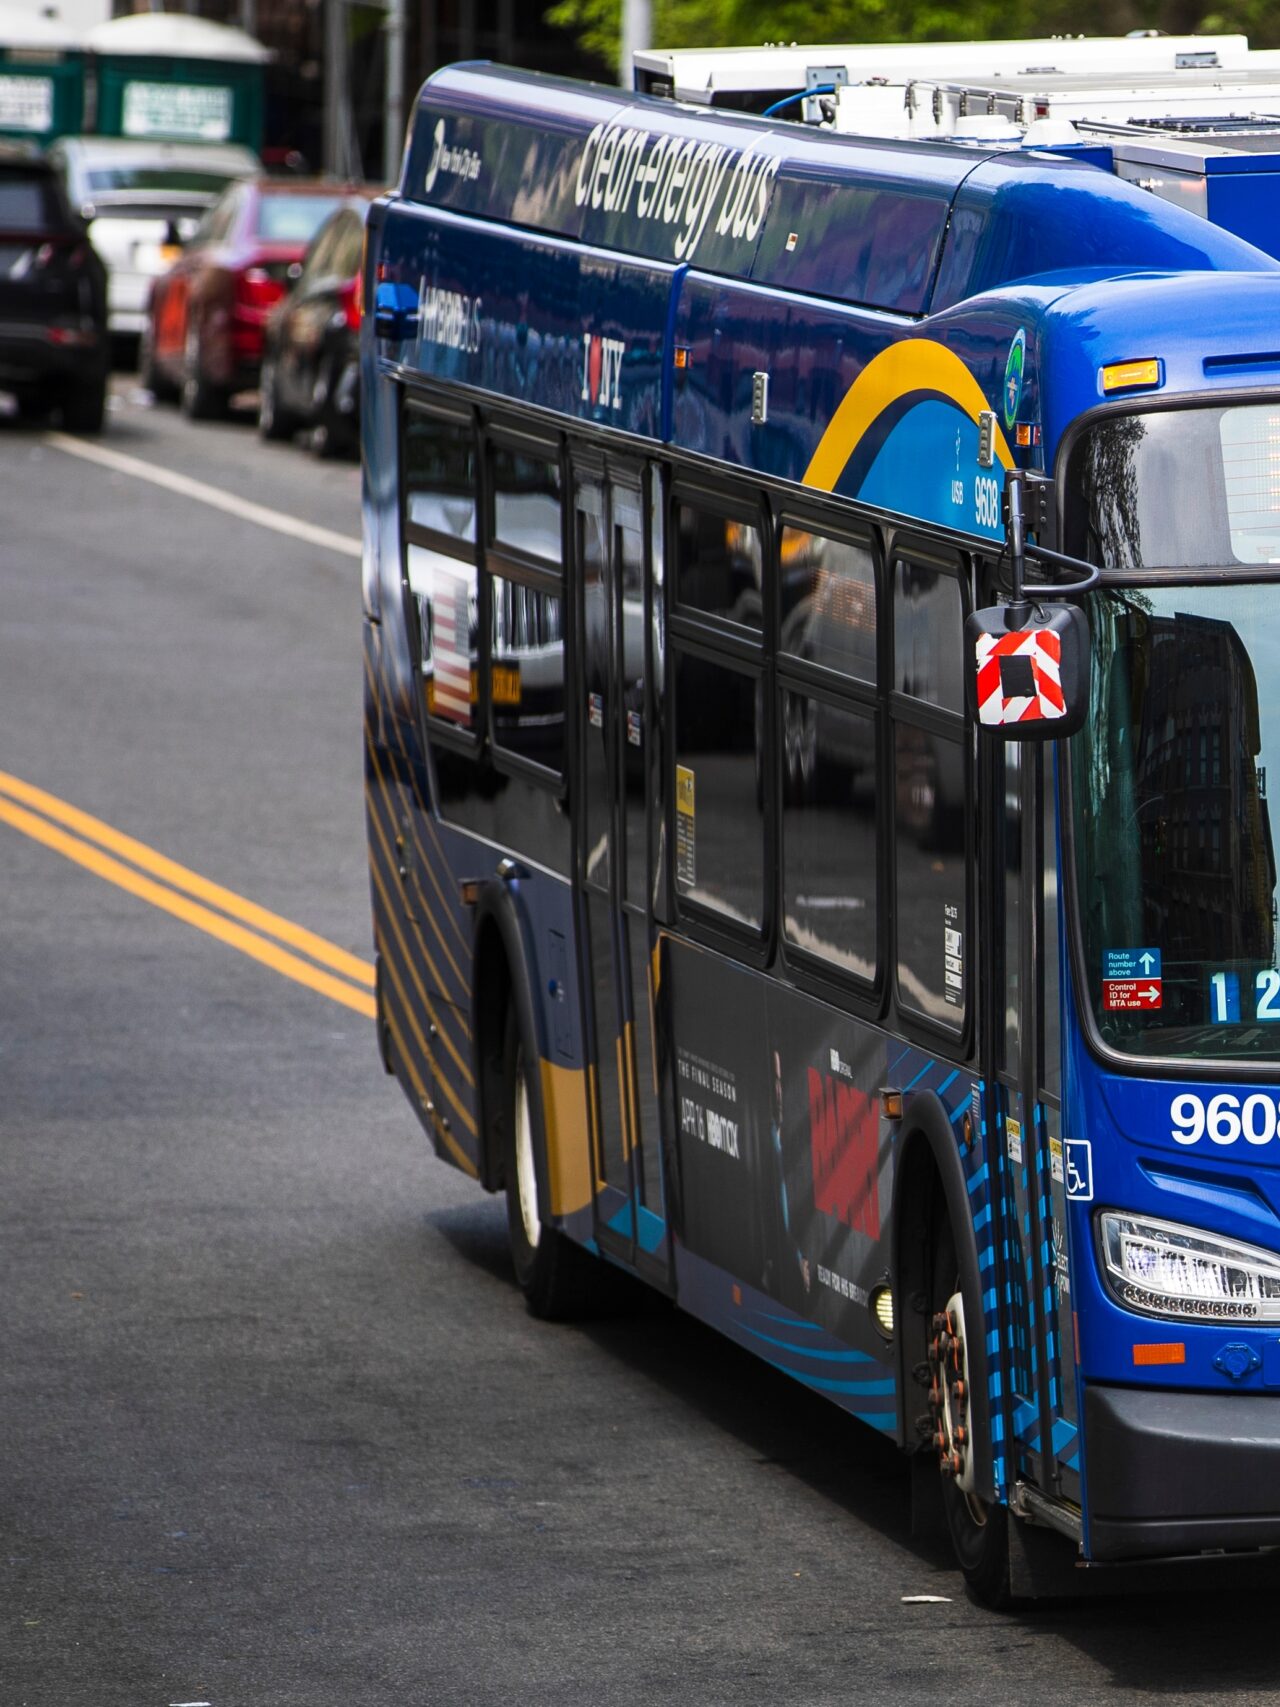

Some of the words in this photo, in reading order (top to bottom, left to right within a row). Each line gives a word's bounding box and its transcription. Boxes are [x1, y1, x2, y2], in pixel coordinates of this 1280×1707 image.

[575, 106, 737, 260] clean-energy
[715, 130, 782, 242] bus
[599, 336, 626, 410] NY
[951, 479, 964, 505] USB
[974, 475, 998, 529] 9608
[1108, 952, 1130, 960] Route
[1109, 983, 1137, 991] Control
[1119, 991, 1131, 999] for
[1211, 971, 1228, 1022] 1
[1256, 969, 1280, 1019] 2
[691, 1066, 711, 1089] FINAL
[712, 1076, 737, 1103] SEASON
